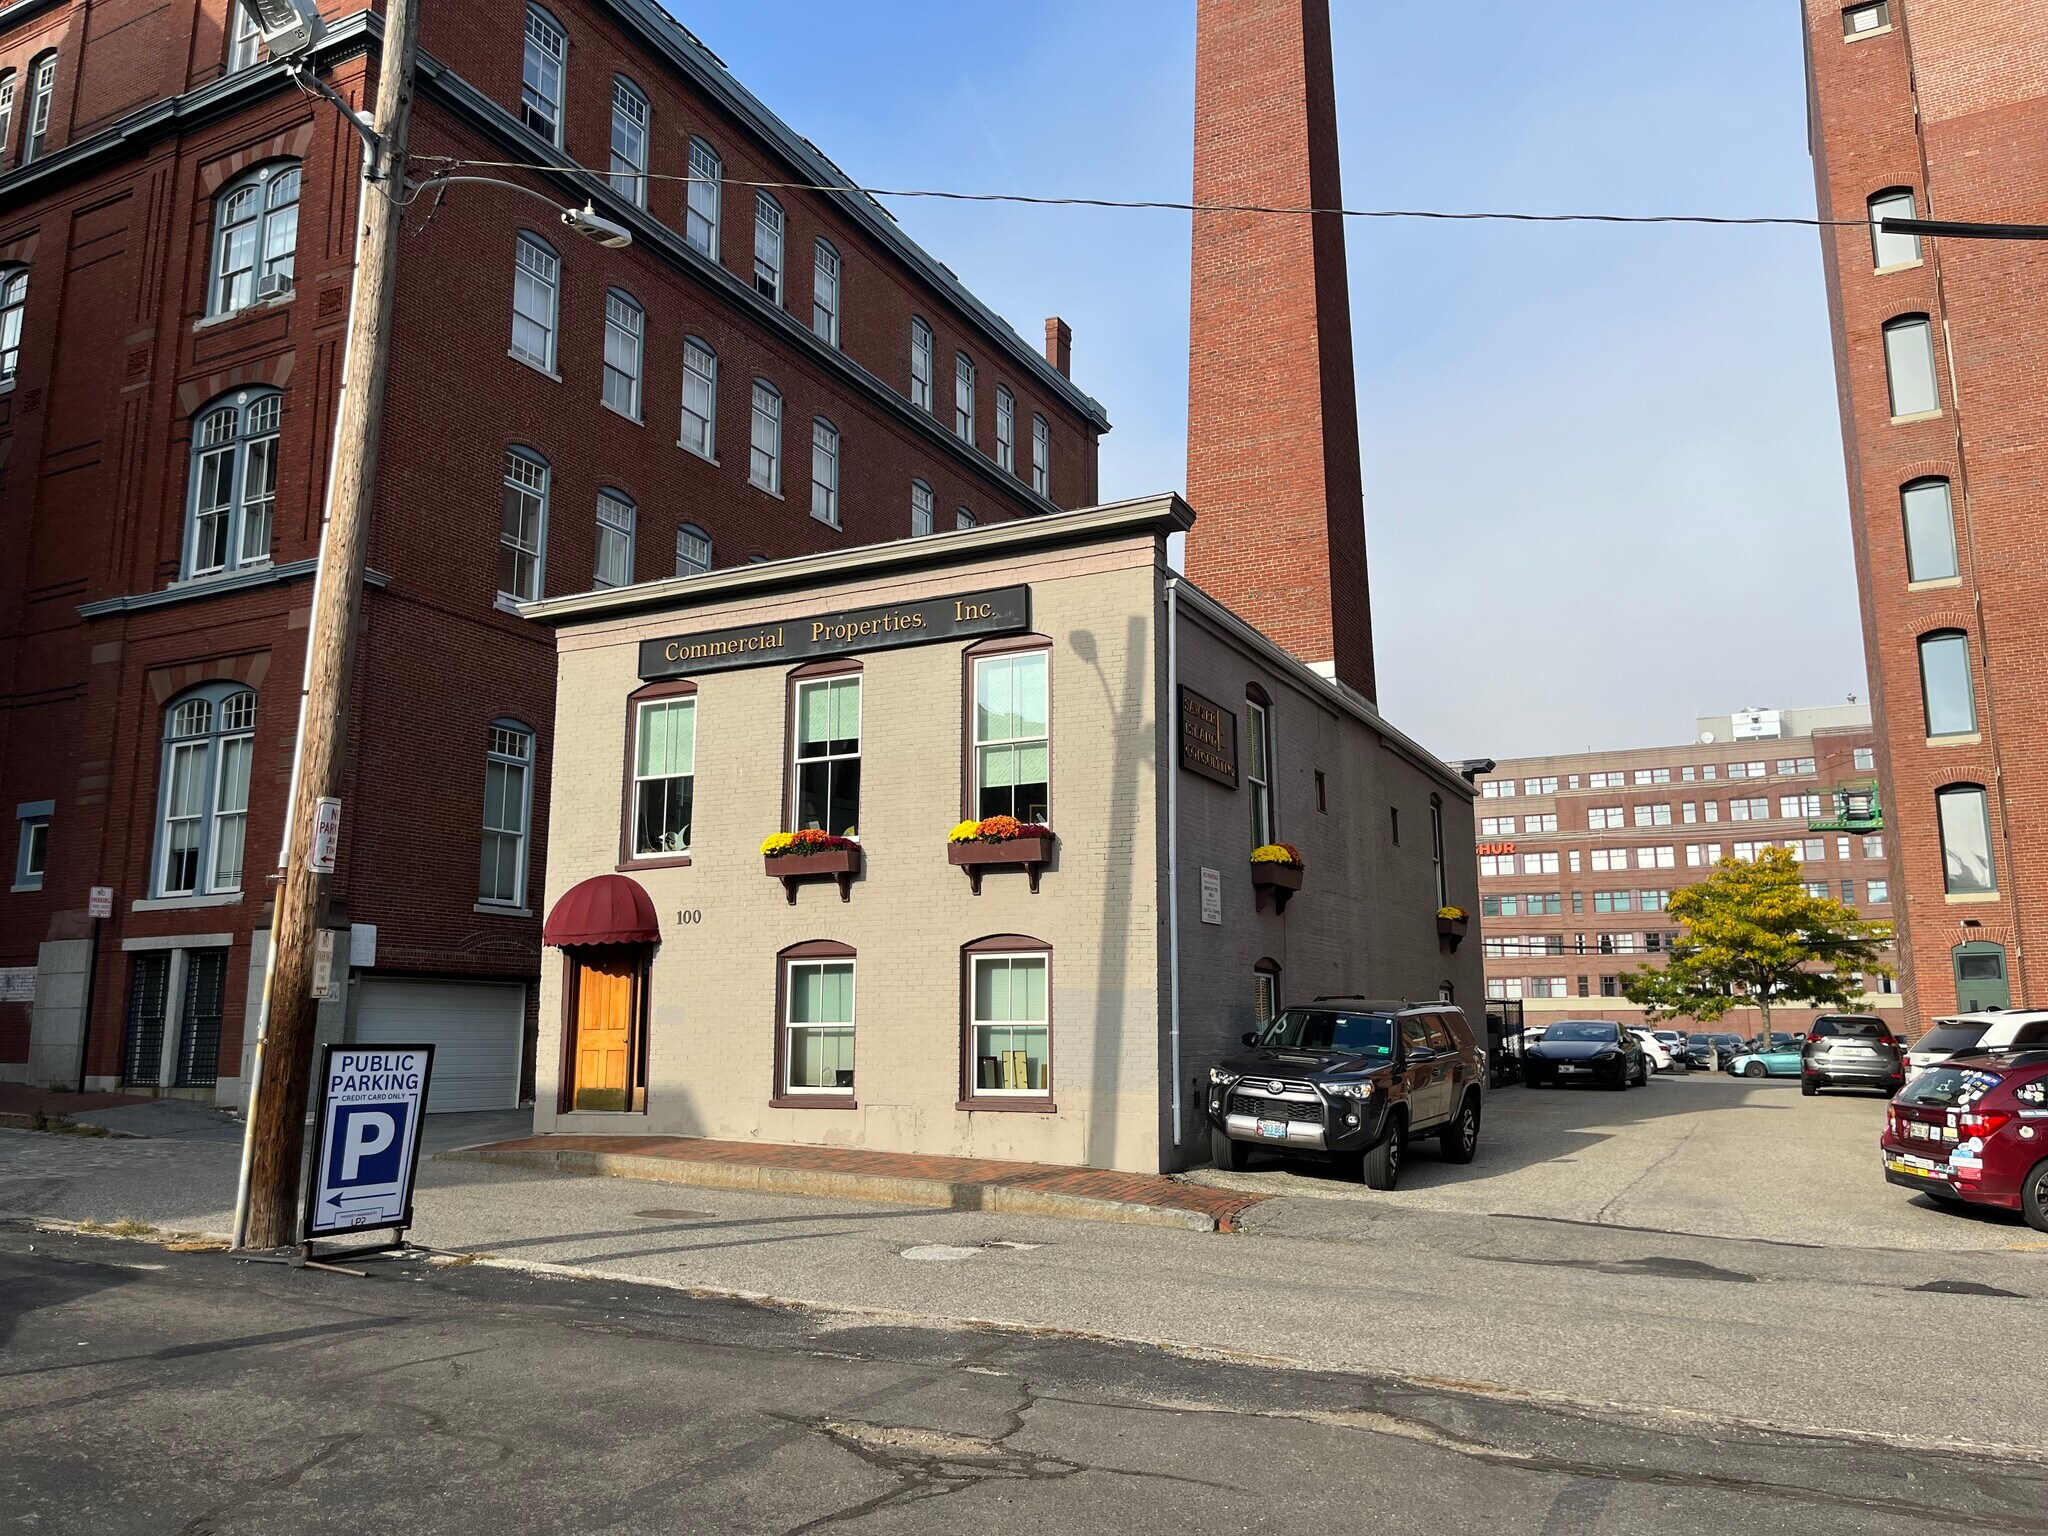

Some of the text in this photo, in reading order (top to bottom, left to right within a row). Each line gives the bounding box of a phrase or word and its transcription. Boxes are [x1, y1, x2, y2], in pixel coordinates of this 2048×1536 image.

[665, 599, 997, 662] Commercial Properties, Inc.
[1476, 842, 1515, 854] HUR
[677, 909, 702, 925] 100
[341, 1055, 415, 1073] PUBLIC
[331, 1074, 419, 1093] PARKING
[341, 1094, 367, 1102] CREDIT
[341, 1111, 396, 1181] P
